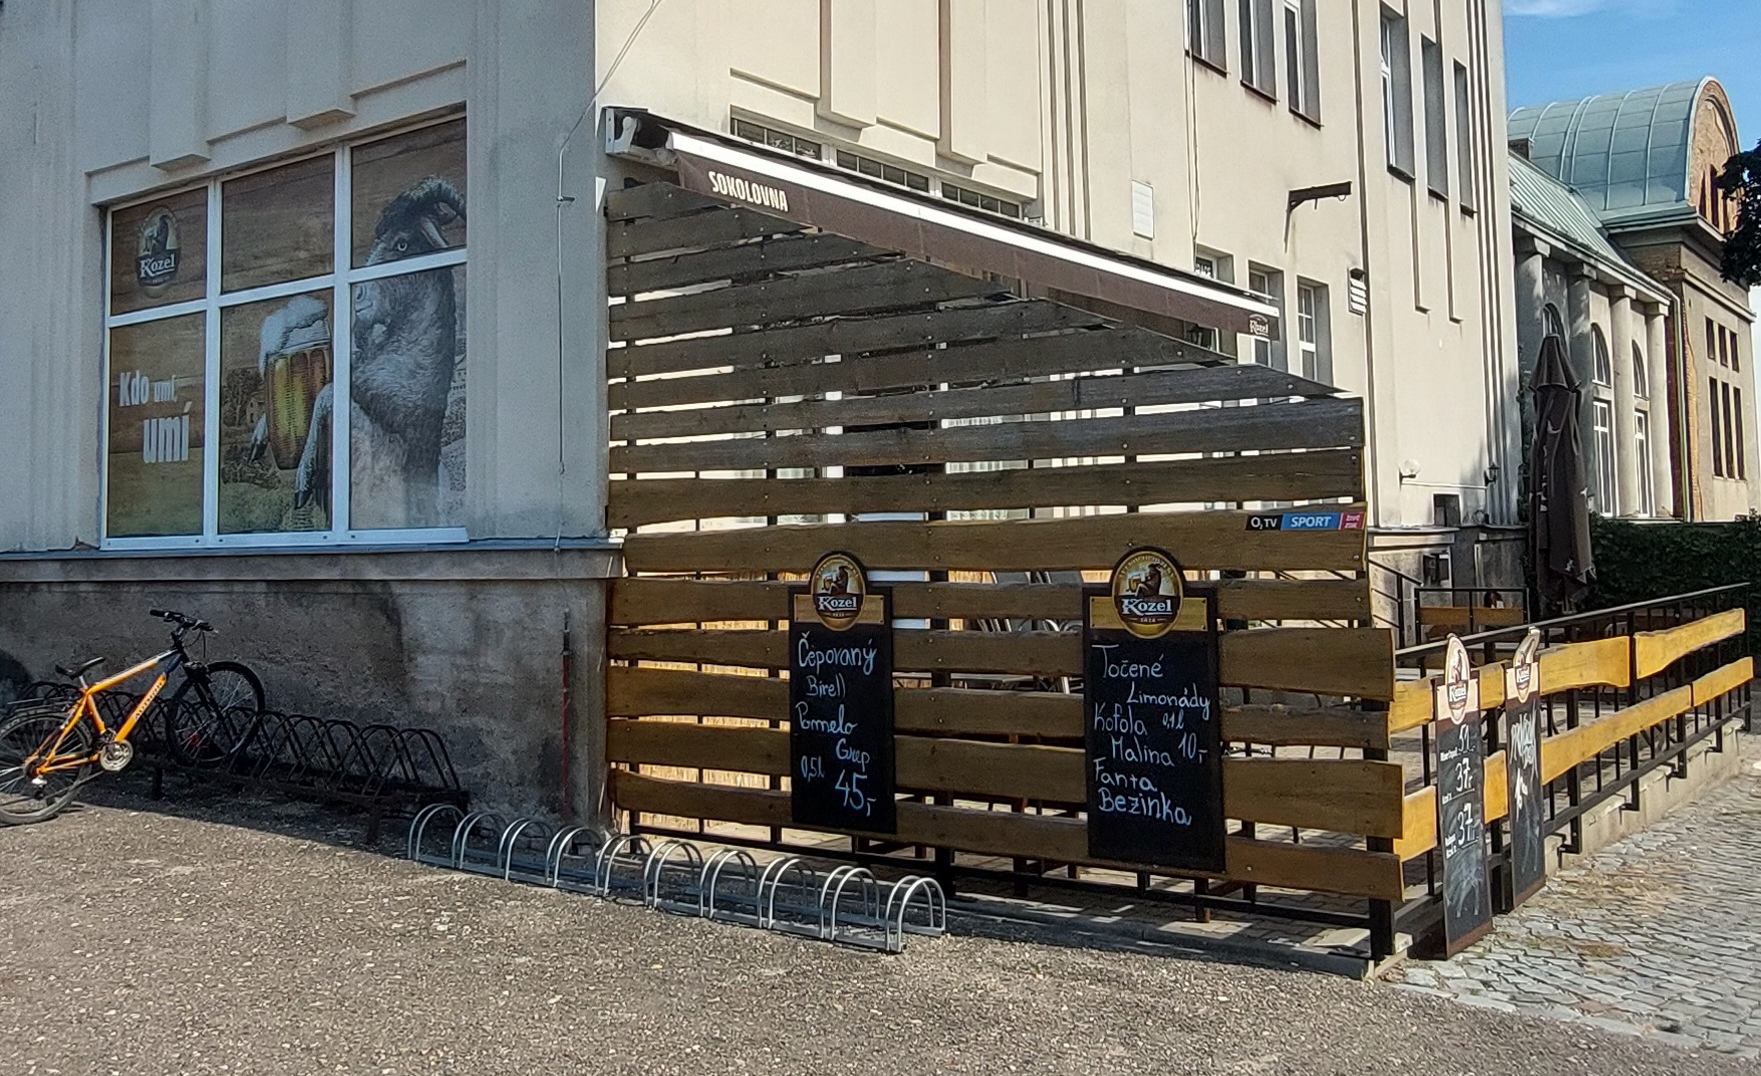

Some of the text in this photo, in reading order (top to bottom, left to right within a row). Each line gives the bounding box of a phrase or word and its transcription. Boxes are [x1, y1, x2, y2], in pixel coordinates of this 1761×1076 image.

[708, 171, 789, 212] SOKOLOVNA
[140, 253, 176, 278] Kozel
[119, 370, 150, 407] Kdo
[143, 401, 193, 464] umí
[1291, 516, 1332, 528] SPORT
[818, 596, 858, 612] Kozel
[1121, 598, 1173, 616] Kozel
[1092, 644, 1165, 678] Točené
[806, 673, 846, 698] Birell
[1126, 681, 1211, 721] Limonády
[795, 701, 858, 735] Pomelo
[1094, 702, 1148, 736] Kofola
[1111, 735, 1175, 767] Malina
[1093, 757, 1158, 792] Fanta
[1098, 787, 1192, 826] Bezinka
